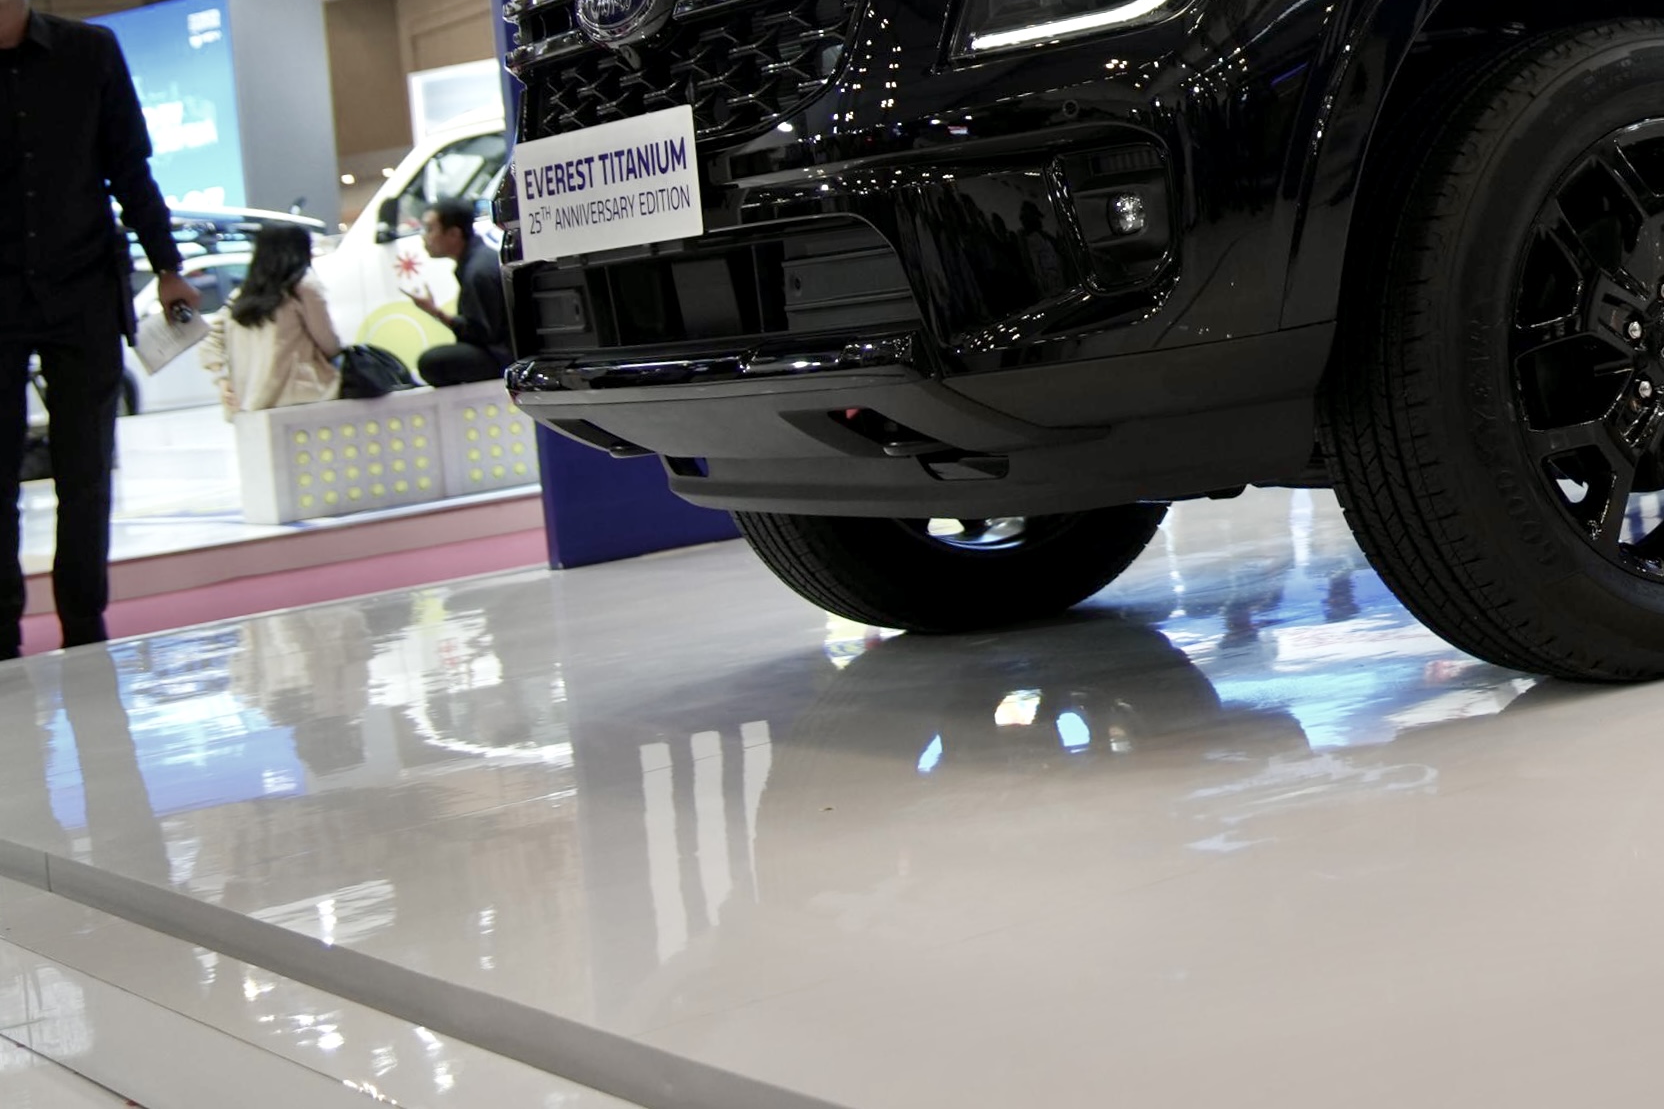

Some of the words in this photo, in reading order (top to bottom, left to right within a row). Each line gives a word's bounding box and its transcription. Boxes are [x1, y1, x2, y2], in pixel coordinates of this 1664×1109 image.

[524, 156, 594, 200] EVEREST
[598, 137, 687, 185] TITANIUM
[555, 194, 635, 230] ANNIVERSARY
[639, 185, 691, 215] EDITION
